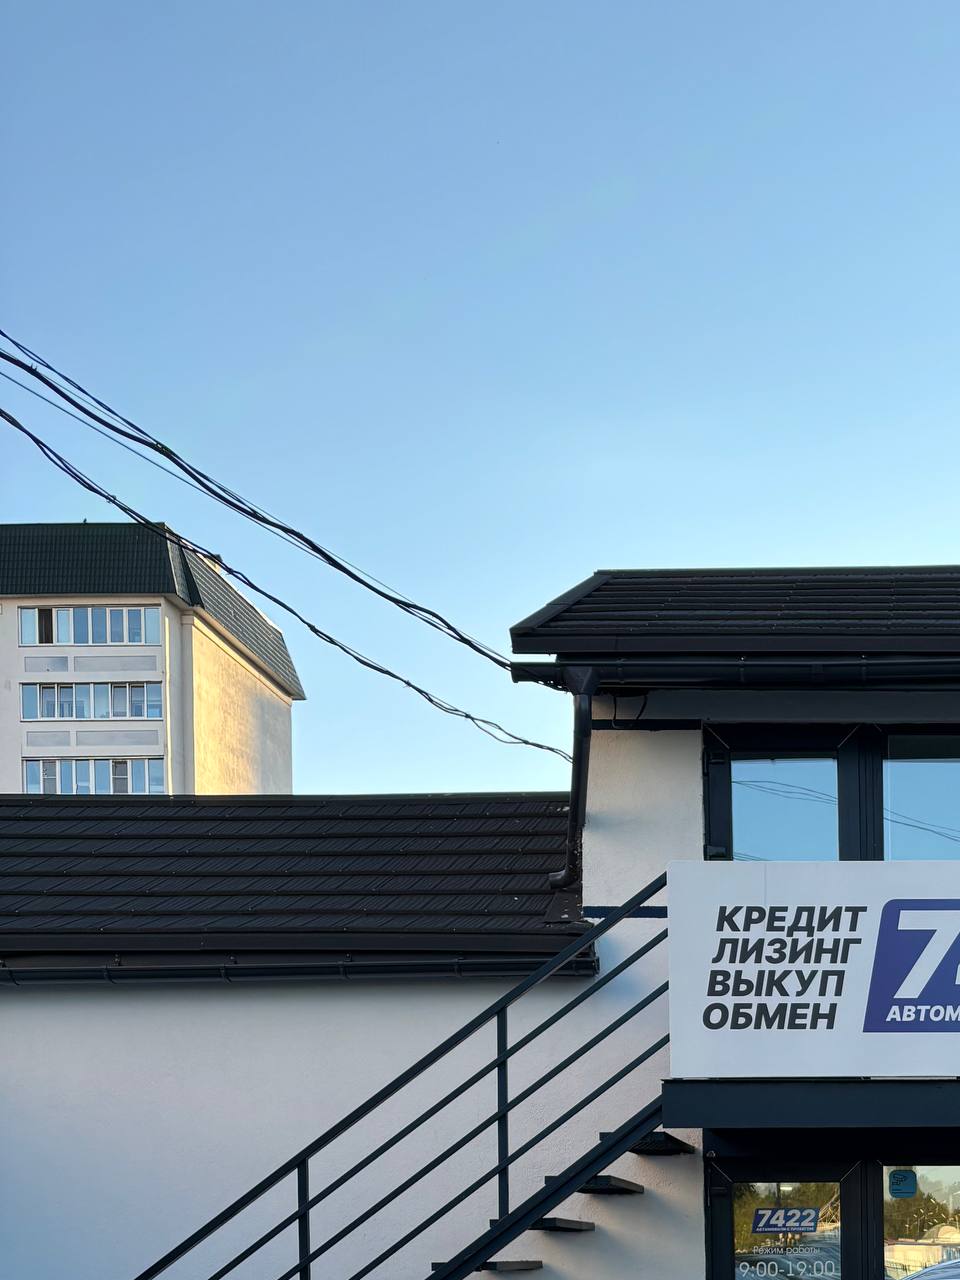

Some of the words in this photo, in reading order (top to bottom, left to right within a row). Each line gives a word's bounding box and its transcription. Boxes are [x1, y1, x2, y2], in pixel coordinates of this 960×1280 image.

[715, 905, 868, 938] КРЕДИТ
[711, 937, 863, 964] ЛИЗИНГ
[706, 969, 846, 997] ВЫКУП
[702, 1002, 838, 1030] ОБМЕН
[757, 1209, 816, 1227] 7422
[753, 1246, 784, 1255] Режим
[786, 1244, 820, 1256] работы
[739, 1260, 835, 1278] 9:00-19:00
